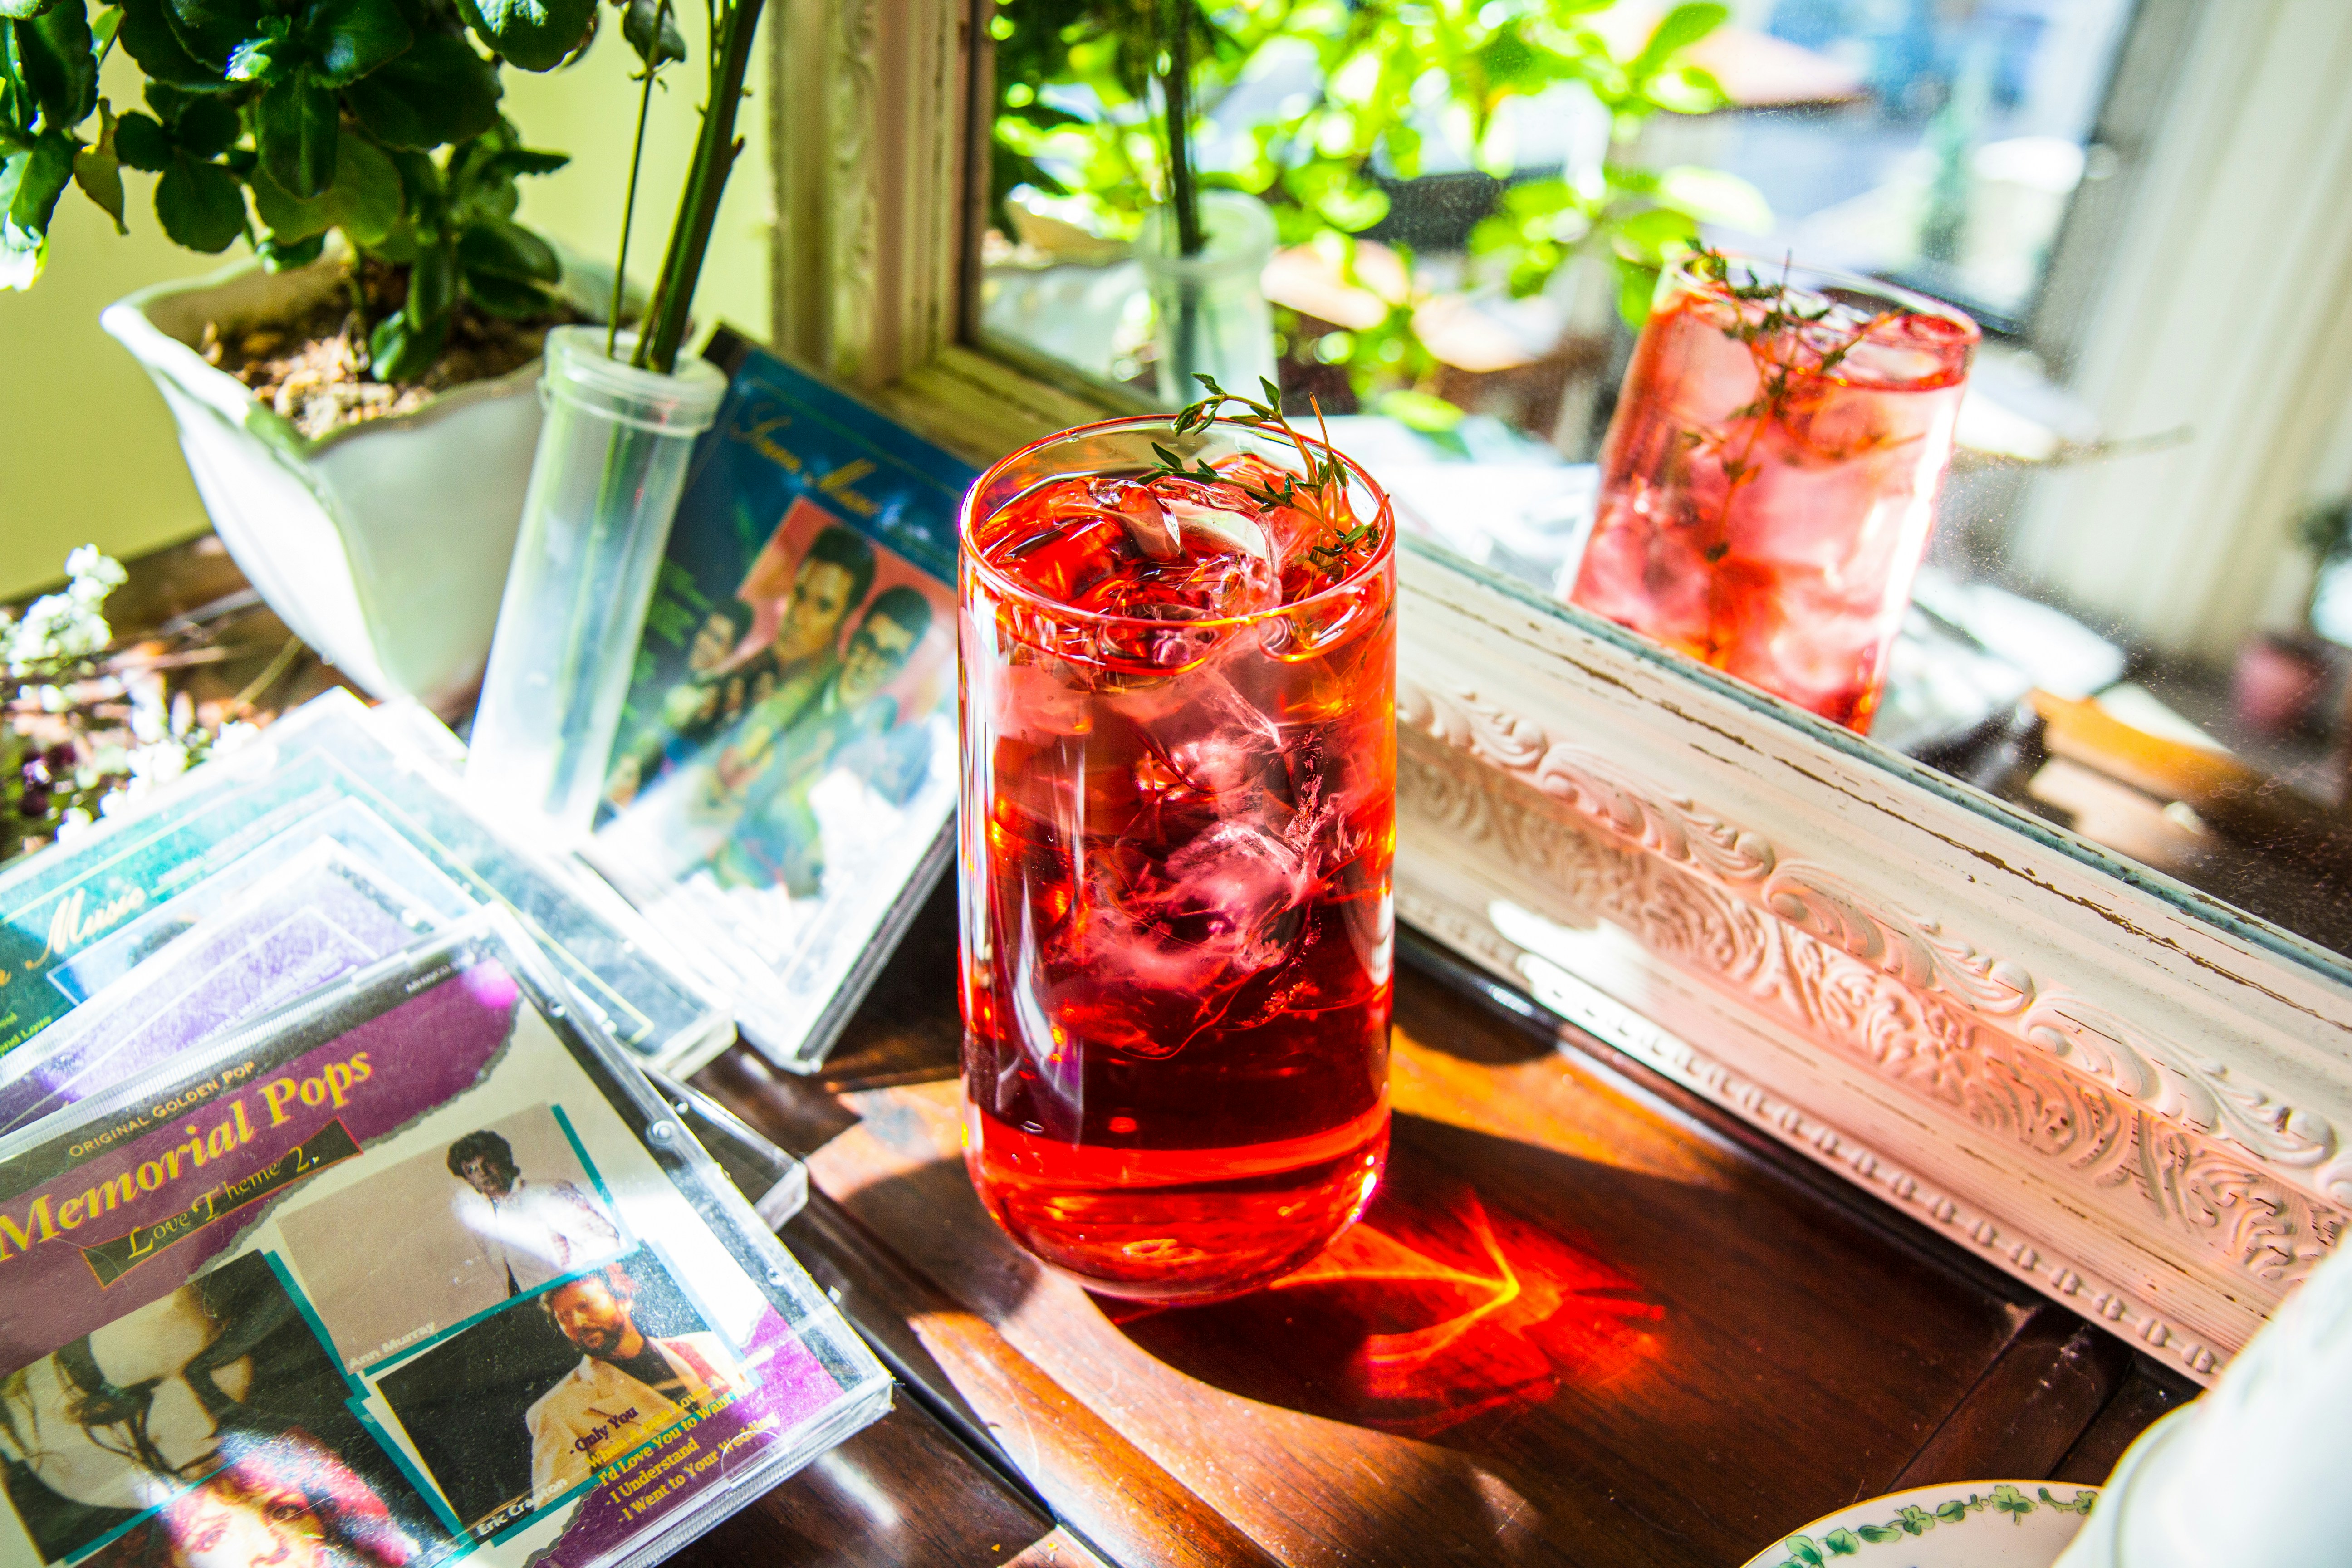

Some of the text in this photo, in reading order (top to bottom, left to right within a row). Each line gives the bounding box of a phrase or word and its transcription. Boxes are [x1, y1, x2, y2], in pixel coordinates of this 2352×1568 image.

[69, 1061, 255, 1156] ORIGINAL GOLDEN POP
[0, 1051, 373, 1262] Memorial Pops
[127, 1212, 191, 1259] Love
[191, 1162, 280, 1220] Theme
[349, 1321, 436, 1369] Ann Murray
[575, 1407, 639, 1451] Only You
[585, 1439, 628, 1468] When
[641, 1409, 673, 1434] man
[598, 1466, 620, 1486] I'd
[617, 1447, 653, 1473] Love
[651, 1427, 682, 1449] You
[681, 1417, 697, 1431] to
[696, 1394, 733, 1420] Want
[622, 1412, 781, 1520] I Went to Your Wedding
[610, 1436, 700, 1503] I Understand
[476, 1514, 508, 1536] Eric
